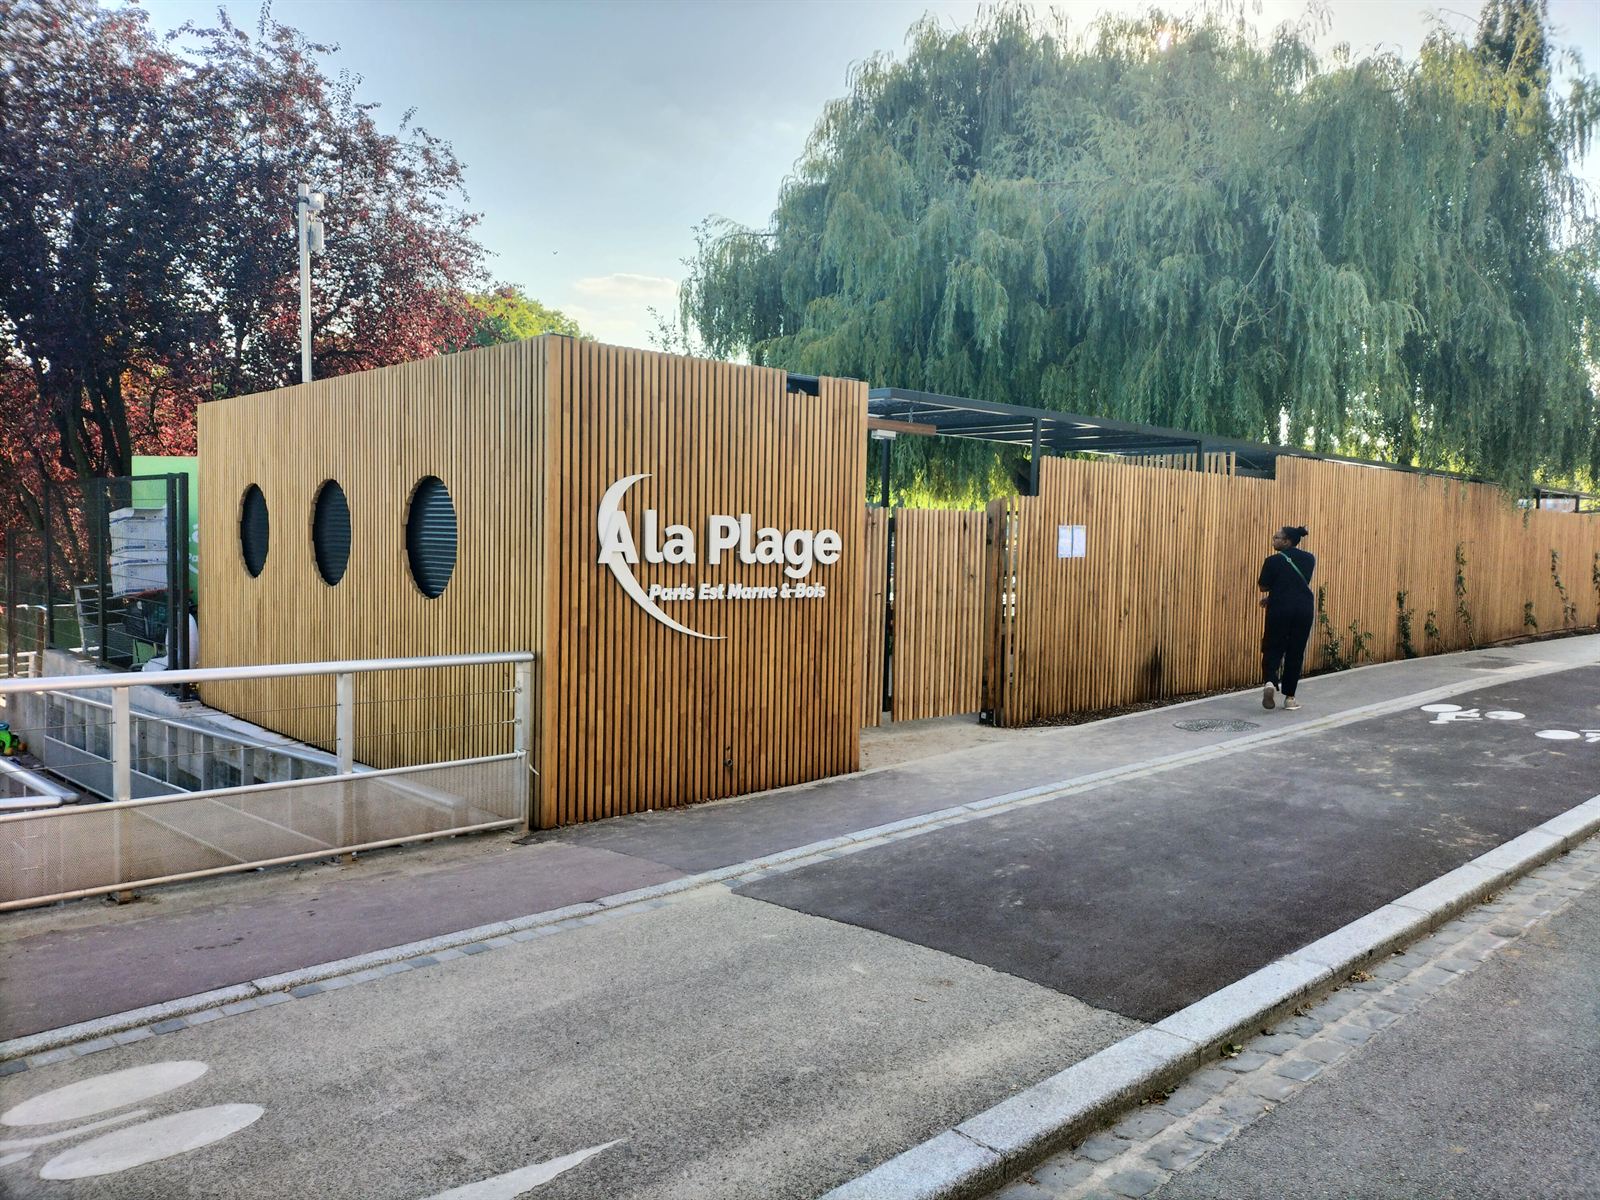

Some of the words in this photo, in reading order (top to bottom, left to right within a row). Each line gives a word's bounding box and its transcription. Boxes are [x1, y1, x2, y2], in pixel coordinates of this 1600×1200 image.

[644, 509, 696, 564] la
[708, 513, 842, 579] Plage
[650, 583, 695, 600] Paris
[699, 583, 725, 600] Est
[727, 583, 778, 600] Marne
